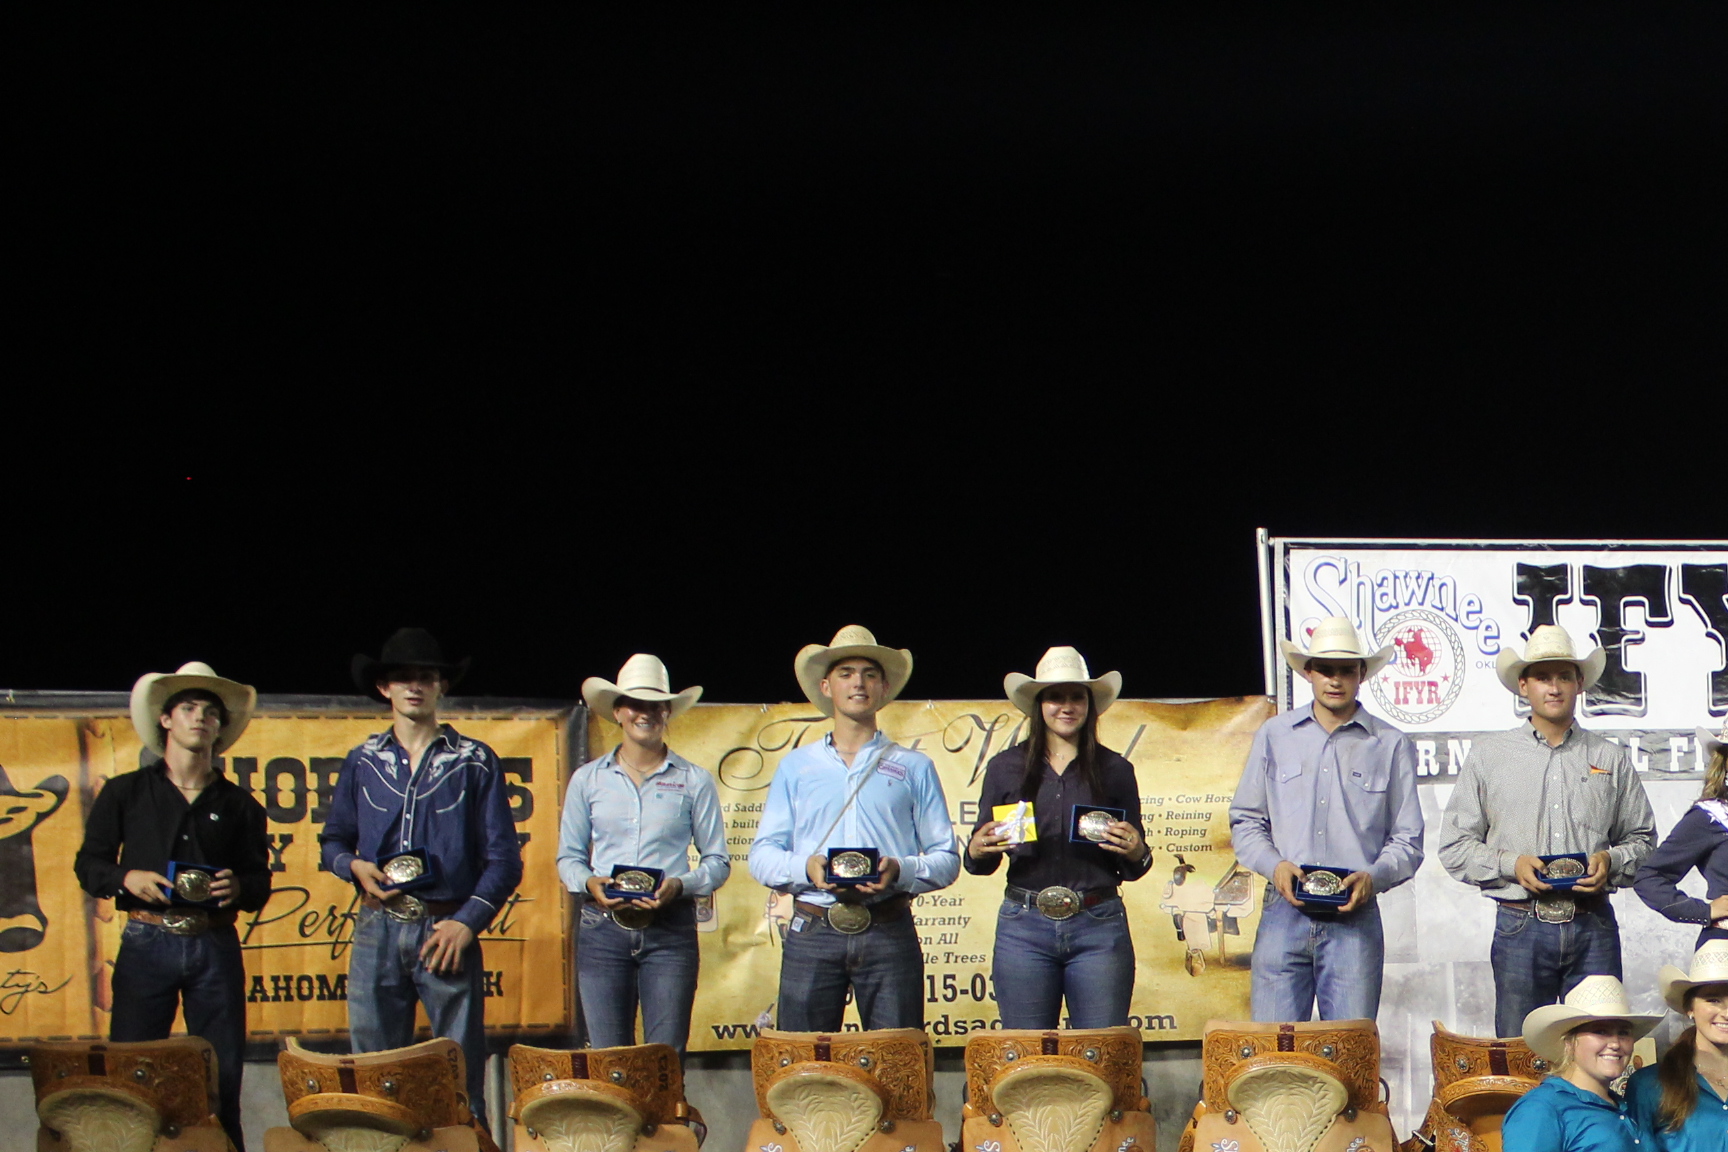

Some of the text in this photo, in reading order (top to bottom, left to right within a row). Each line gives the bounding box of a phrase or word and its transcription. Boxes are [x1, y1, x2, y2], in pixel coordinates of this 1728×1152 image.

[1300, 556, 1500, 664] Shawnee
[1394, 681, 1441, 705] IFYR
[1140, 793, 1233, 806] cing Cow Hors
[1166, 810, 1212, 822] Reining
[732, 819, 760, 829] built
[1165, 826, 1207, 839] Roping
[1166, 843, 1213, 853] Custom
[912, 914, 971, 928] arranty
[937, 932, 959, 945] All
[943, 951, 987, 964] Trees
[247, 973, 349, 1003] AHOM
